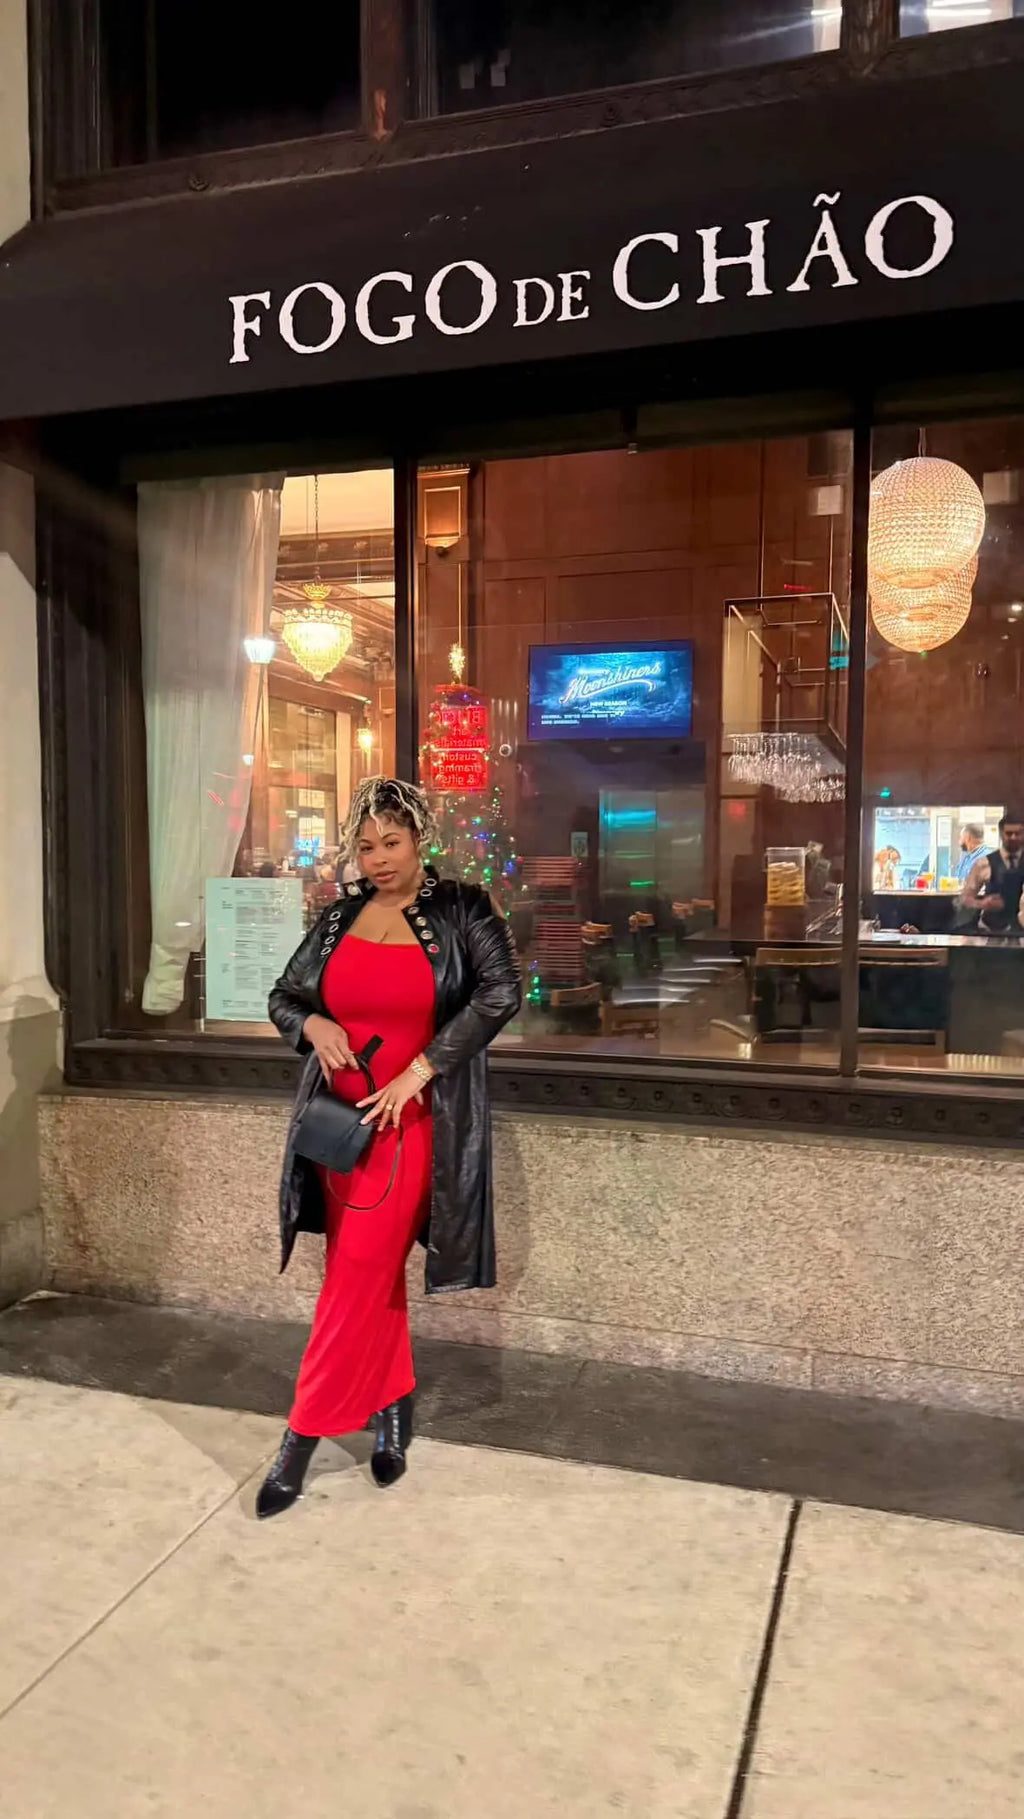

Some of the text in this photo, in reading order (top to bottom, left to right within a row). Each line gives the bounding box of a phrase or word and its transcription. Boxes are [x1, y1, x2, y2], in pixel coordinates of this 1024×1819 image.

[228, 191, 954, 364] FOGO DE CHÃO
[559, 661, 662, 703] Moonshiners
